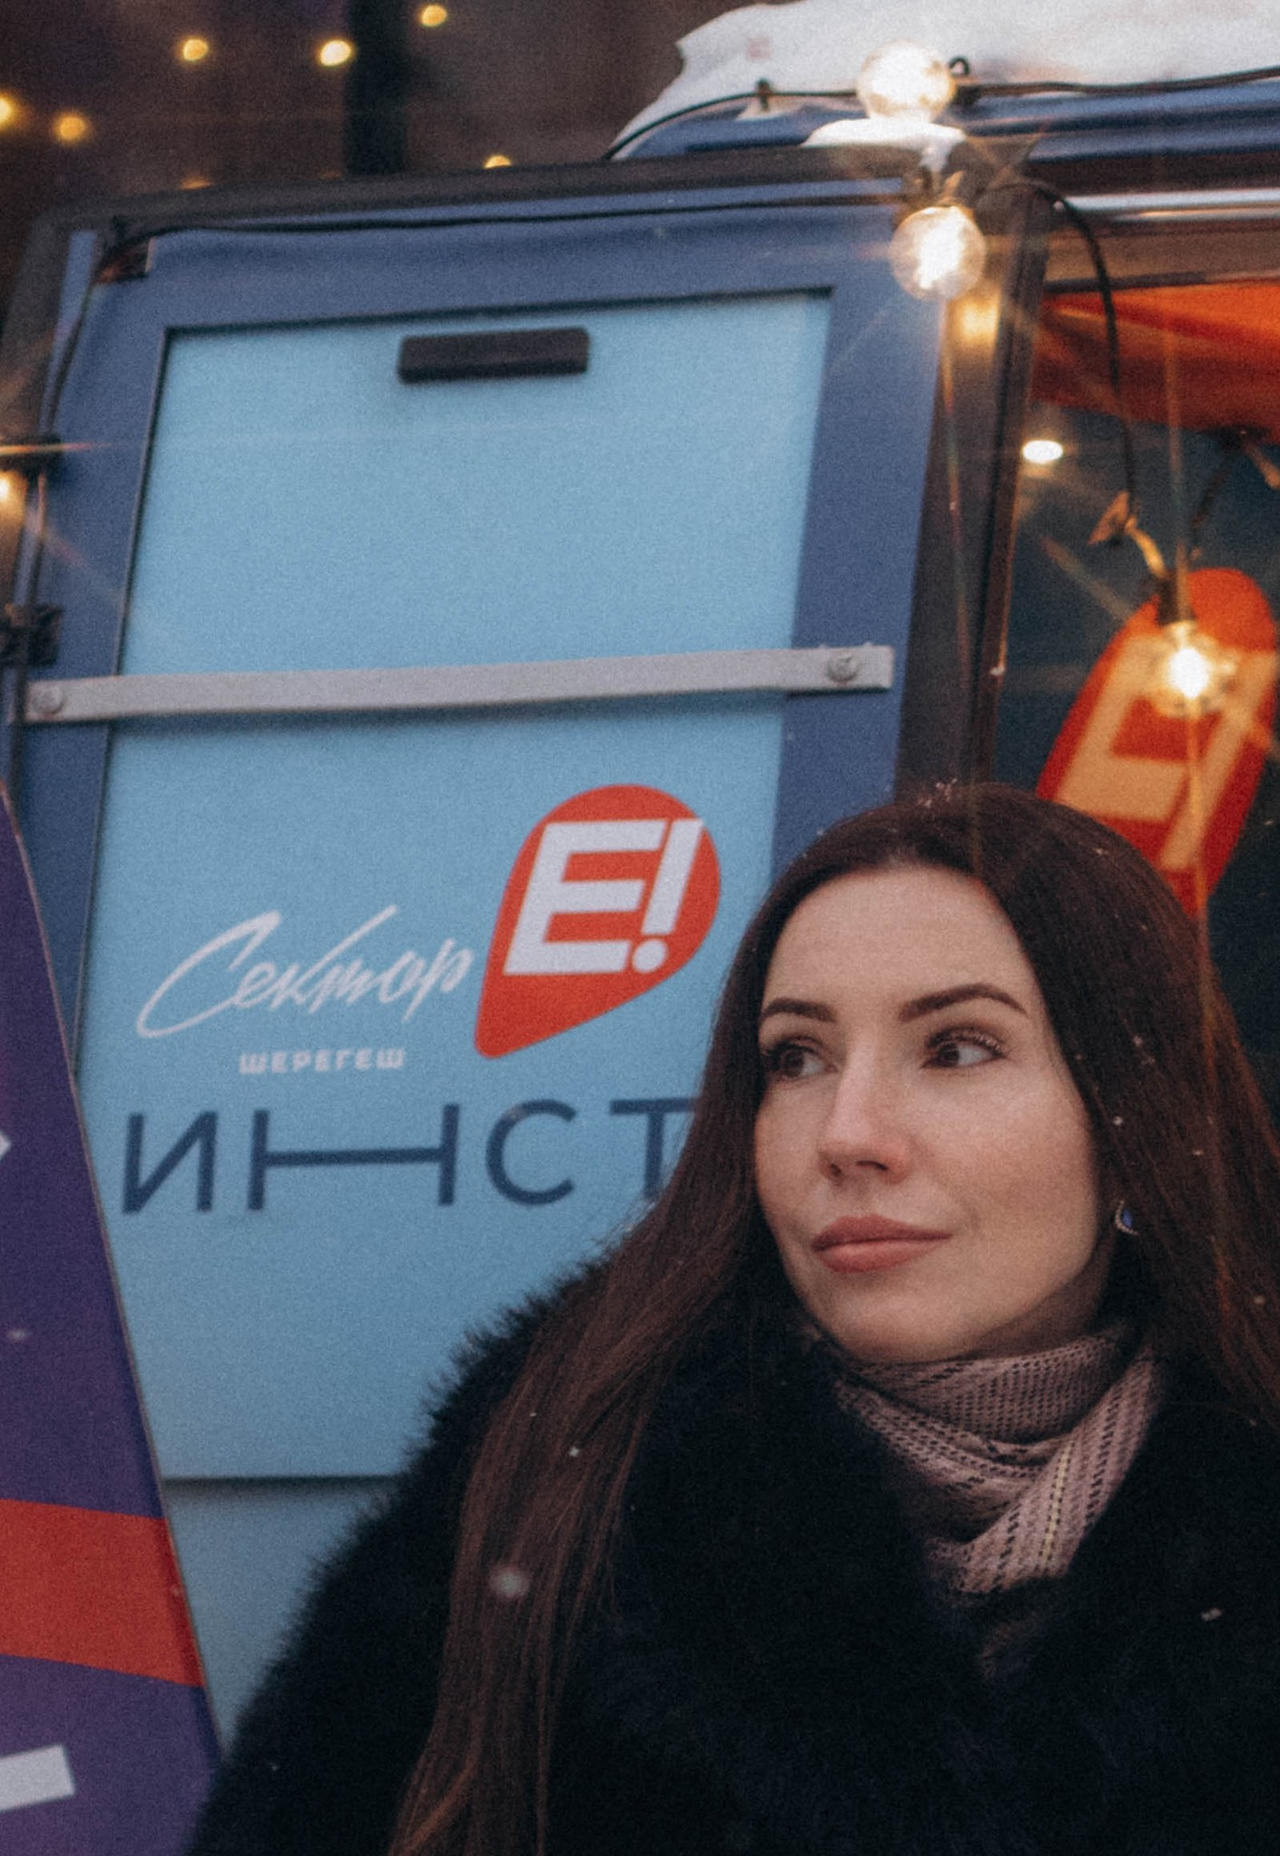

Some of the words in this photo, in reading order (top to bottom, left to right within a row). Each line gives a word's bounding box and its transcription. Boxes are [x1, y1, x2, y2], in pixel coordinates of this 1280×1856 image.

[137, 904, 474, 1038] Сектор
[503, 818, 704, 976] Е!
[239, 1047, 406, 1075] ШЕРЕГЕШ
[122, 1097, 698, 1215] ИНСТ
